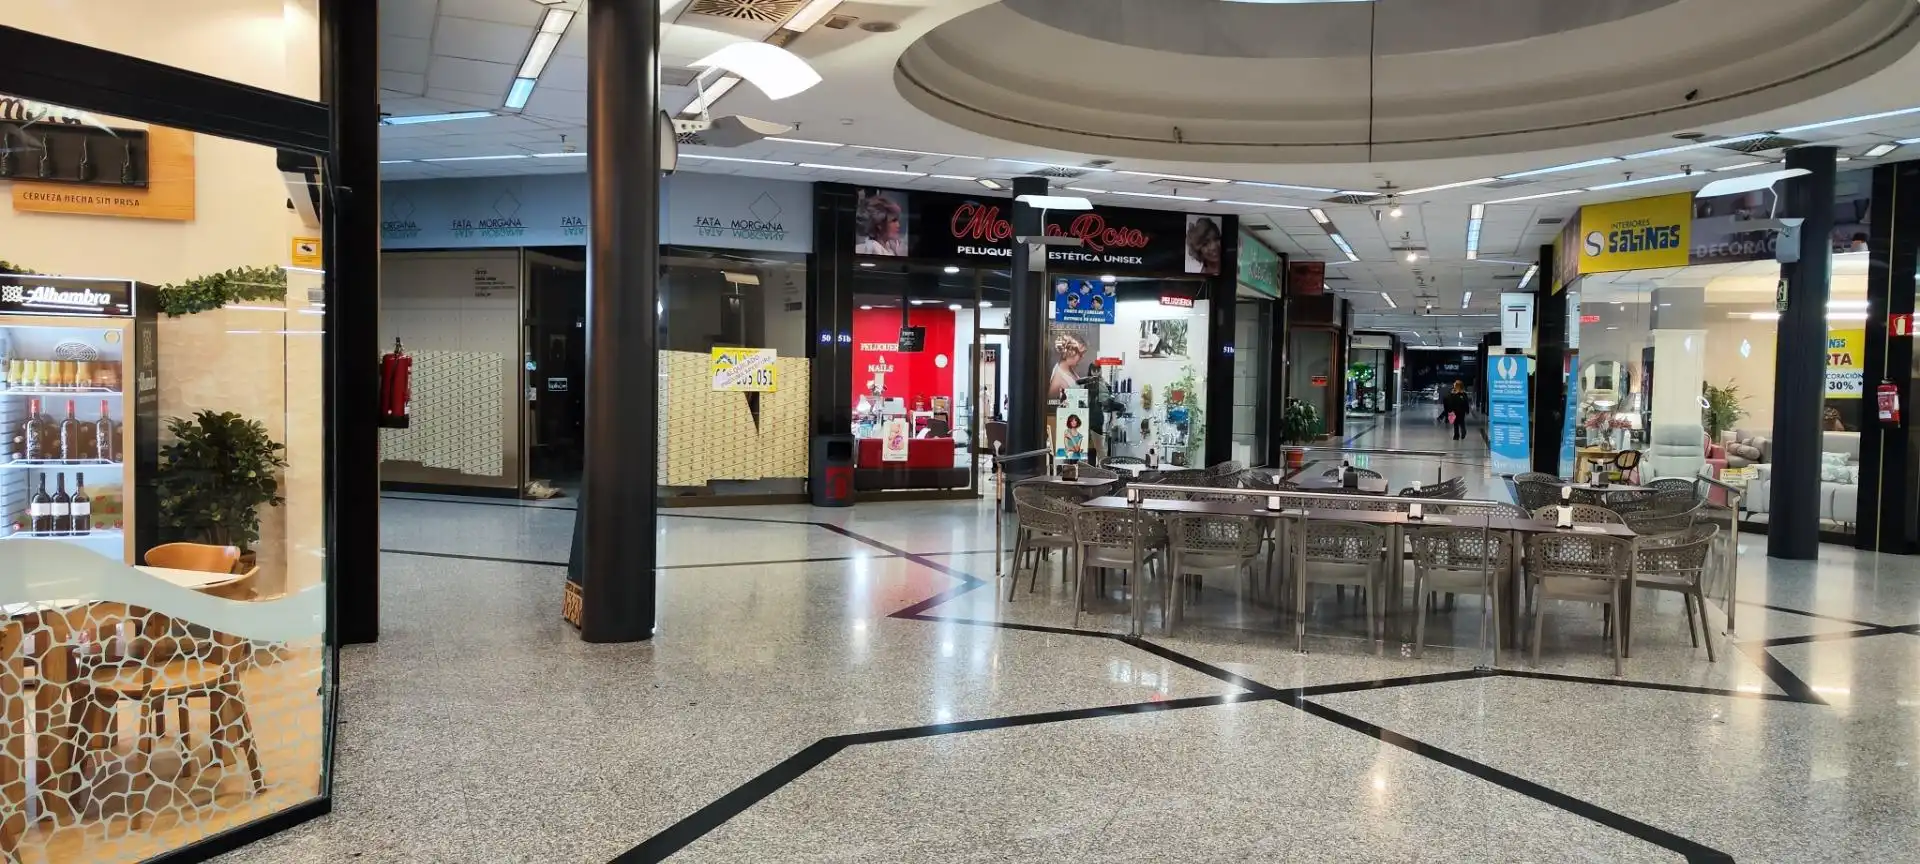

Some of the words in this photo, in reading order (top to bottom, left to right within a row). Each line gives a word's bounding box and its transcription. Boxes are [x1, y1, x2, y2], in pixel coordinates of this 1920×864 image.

[23, 191, 62, 203] CERVEZA
[64, 195, 93, 205] HECHA
[96, 197, 111, 205] SIN
[452, 219, 473, 229] FATA
[479, 217, 522, 228] MORGANA
[562, 215, 583, 226] FATA
[696, 216, 722, 226] FATA
[731, 219, 784, 231] MORGANA
[1611, 218, 1650, 229] INTERIORES
[1070, 213, 1149, 251] Rosa
[1049, 250, 1100, 263] ESTÉTICA
[1104, 254, 1142, 265] UNISEX
[27, 286, 111, 305] Alhambra
[822, 334, 832, 342] 50
[837, 334, 851, 343] 51b
[867, 364, 894, 372] NAILS
[756, 369, 773, 385] 051
[1828, 381, 1854, 390] 30%
